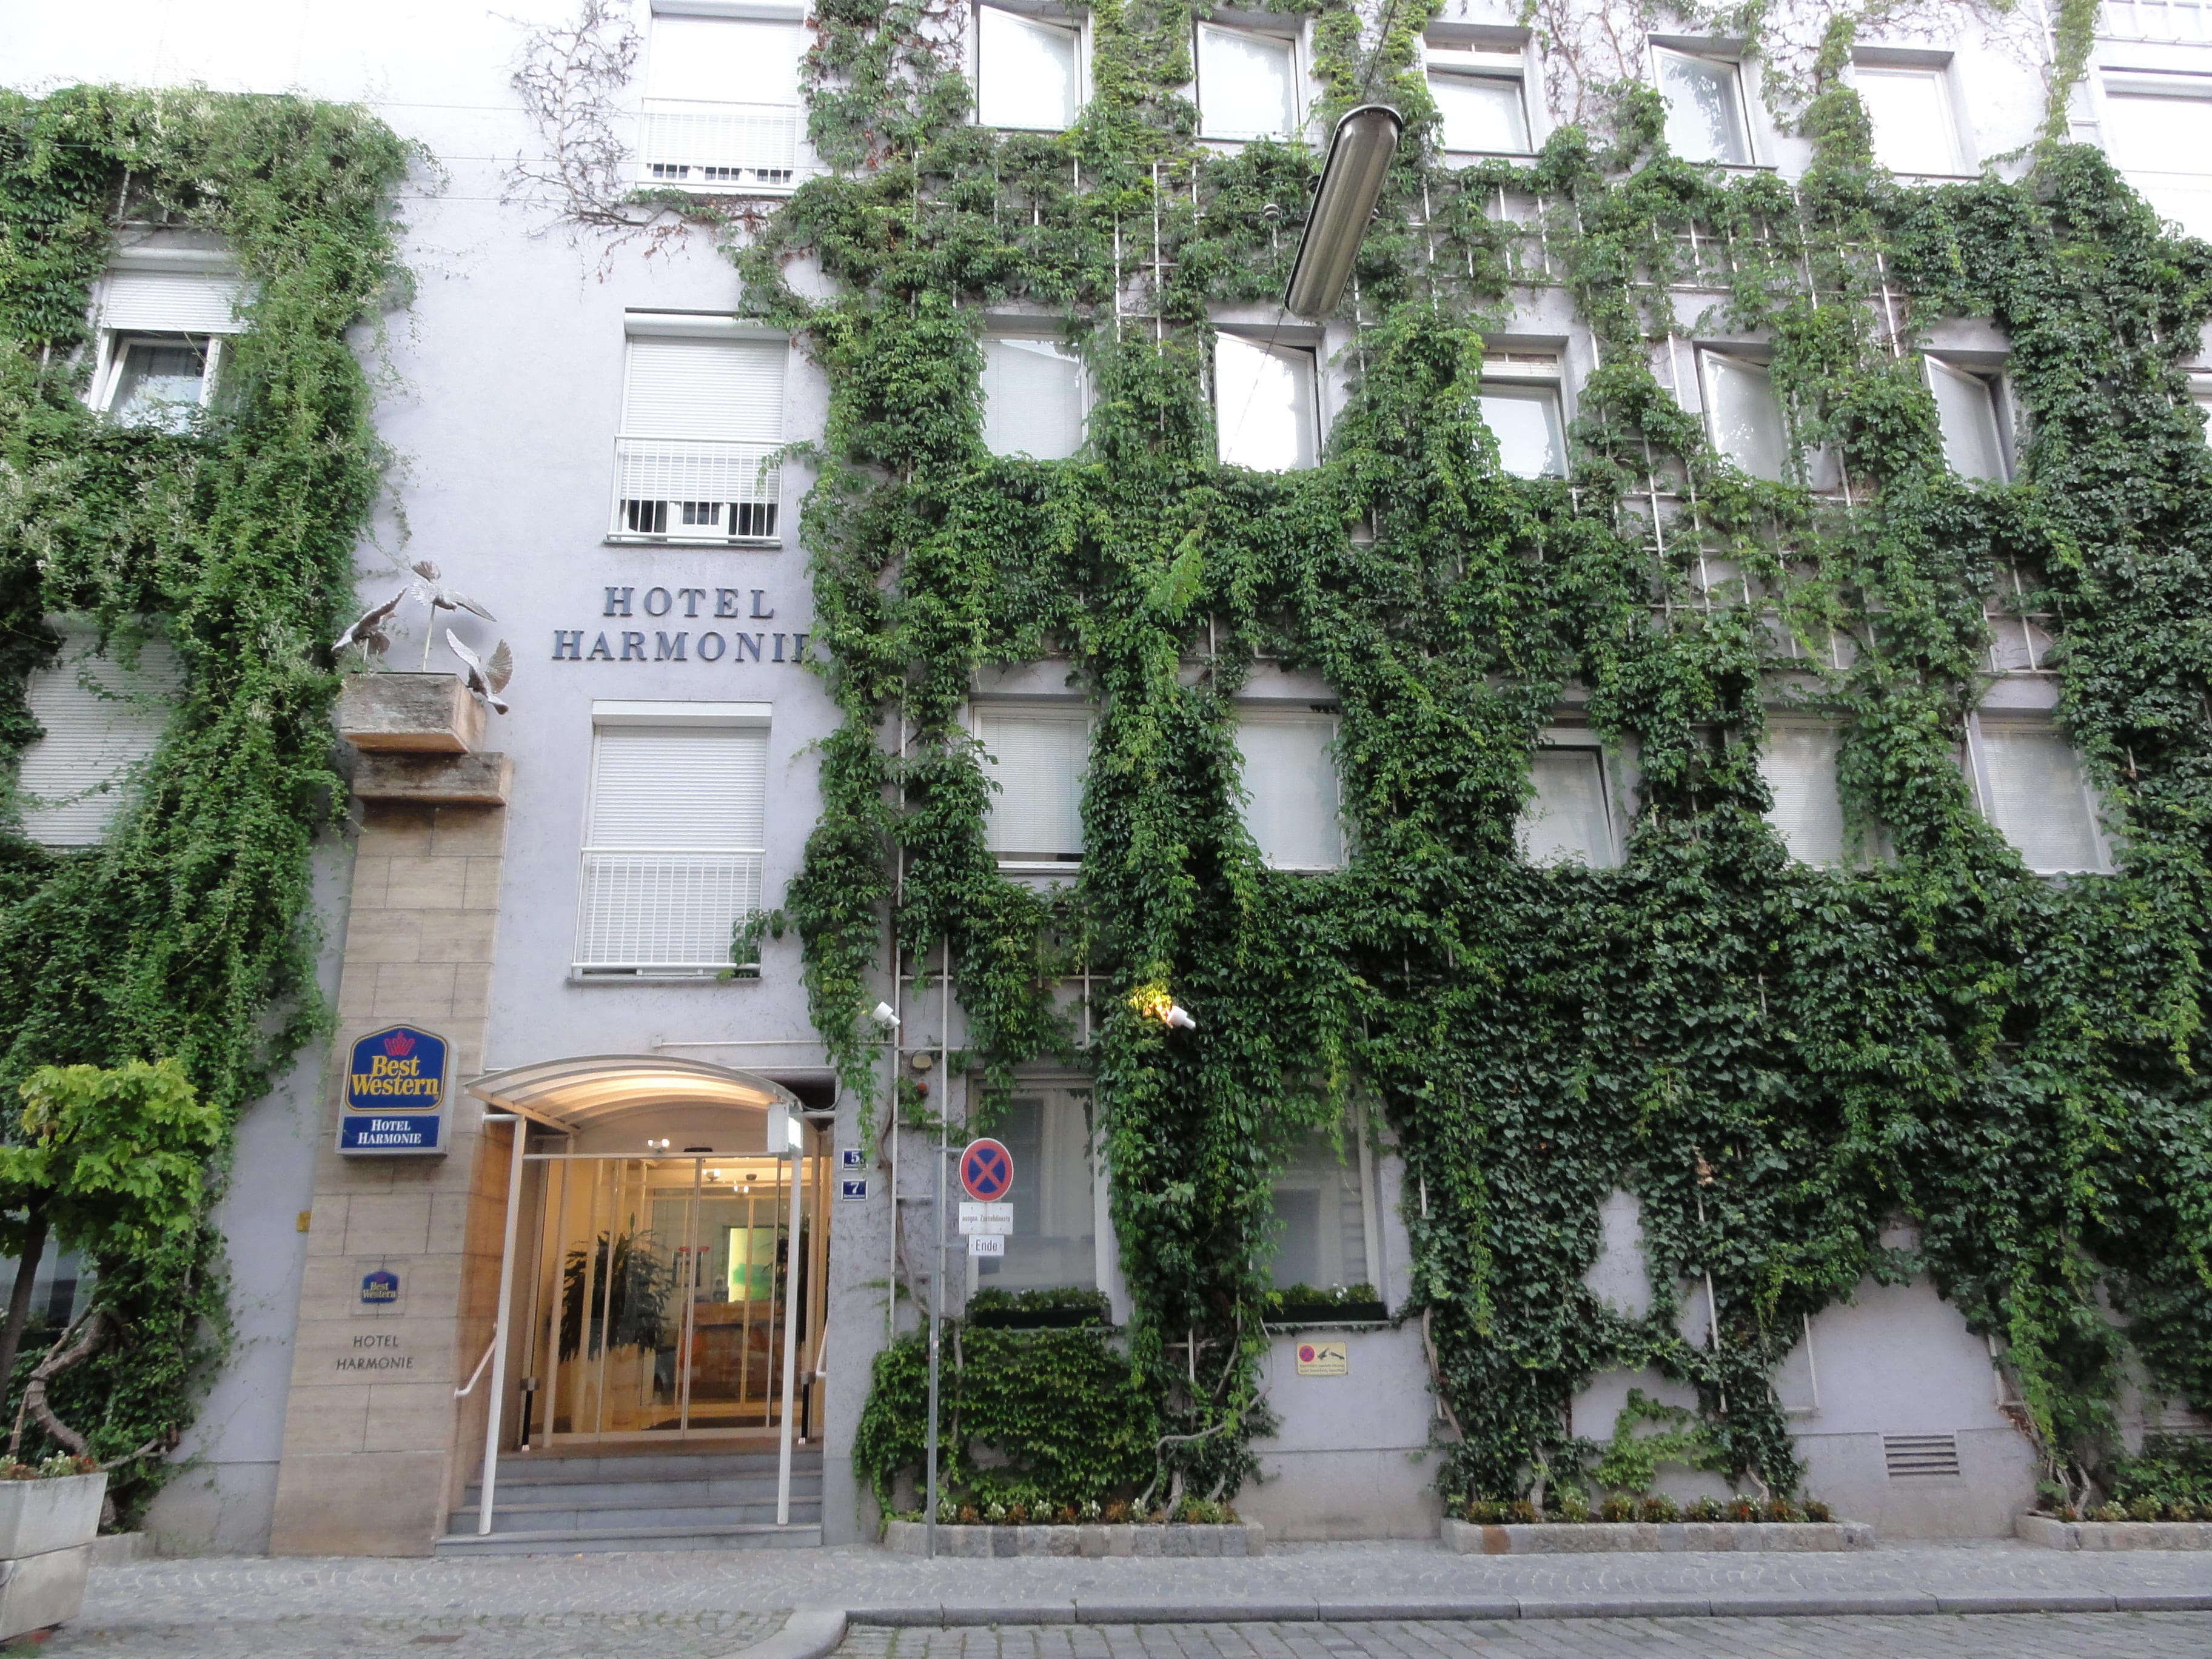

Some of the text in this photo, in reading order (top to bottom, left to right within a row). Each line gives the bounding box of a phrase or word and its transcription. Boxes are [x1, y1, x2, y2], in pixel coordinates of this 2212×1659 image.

[603, 586, 774, 618] HOTEL
[370, 1055, 421, 1077] Best
[351, 1074, 439, 1096] Western
[371, 1119, 411, 1132] HOTEL
[357, 1132, 422, 1144] HARMONIE
[851, 1151, 860, 1163] 5
[850, 1182, 860, 1194] 7
[976, 1239, 998, 1252] Ende
[370, 1281, 389, 1291] Best
[363, 1289, 397, 1298] Western
[353, 1335, 399, 1348] HOTEL
[336, 1356, 415, 1370] HARMONIE
